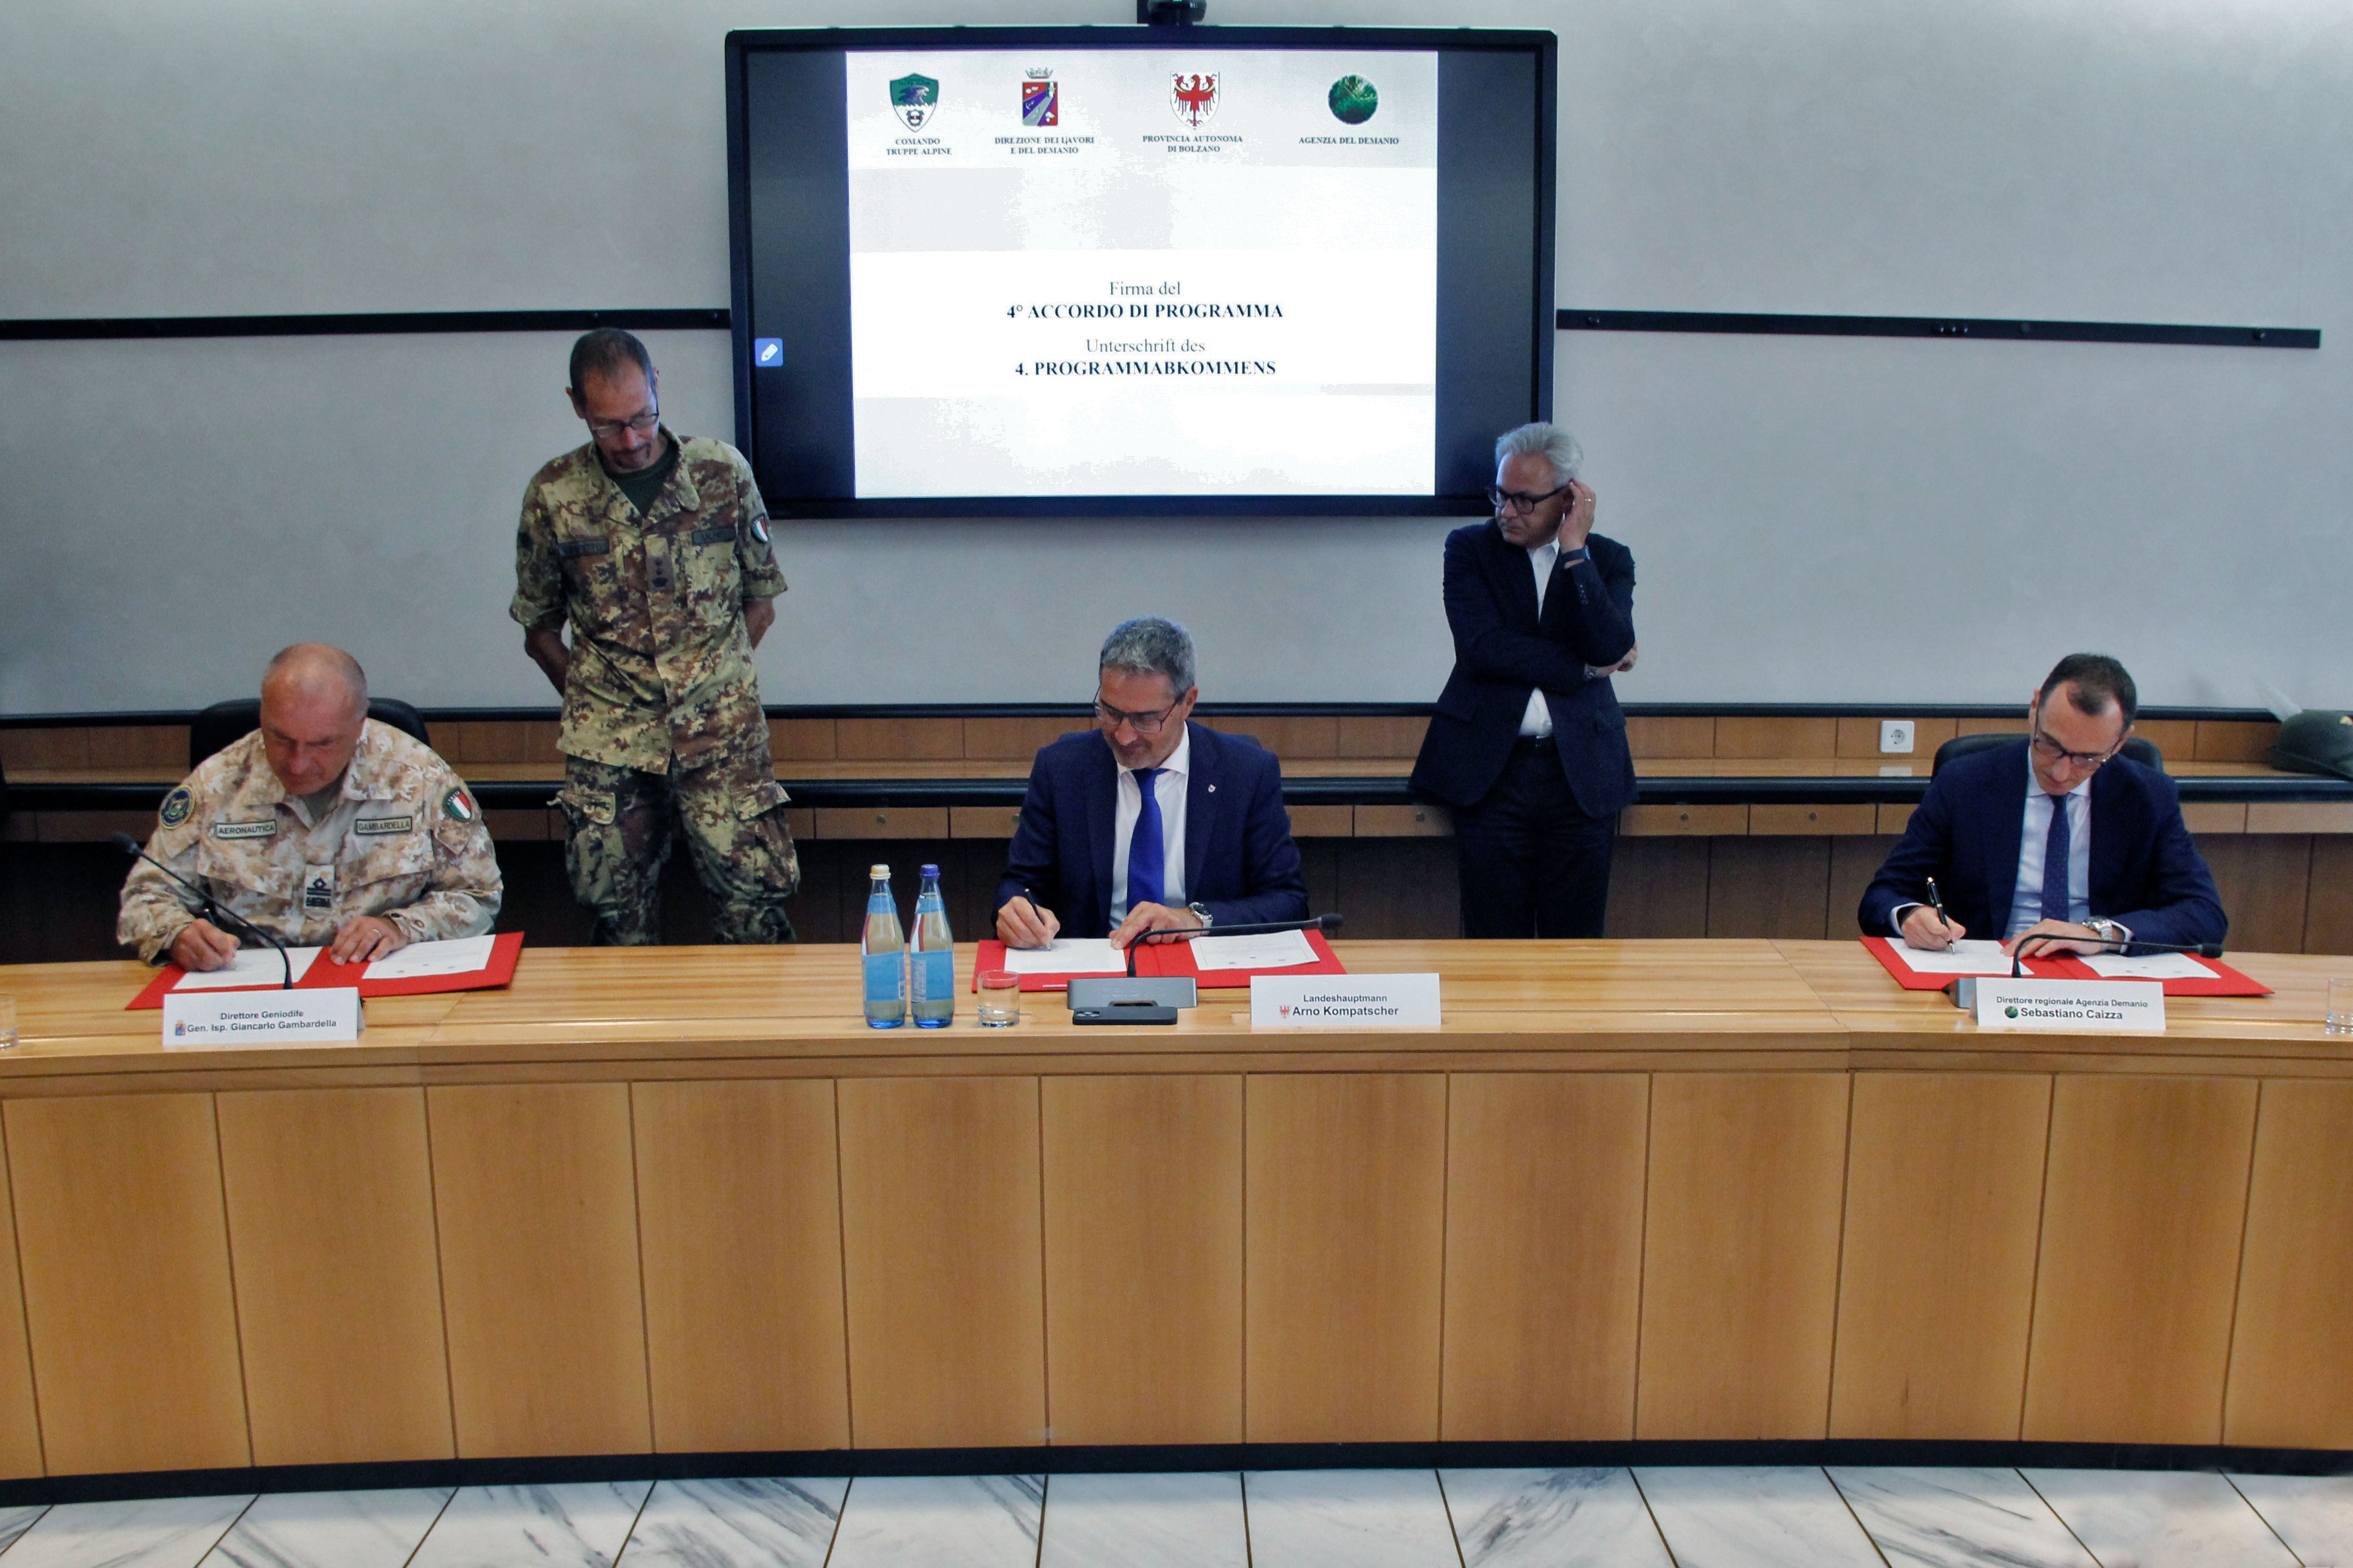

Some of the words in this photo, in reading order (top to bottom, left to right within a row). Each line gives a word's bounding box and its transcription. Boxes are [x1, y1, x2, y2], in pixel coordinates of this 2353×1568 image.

[1110, 282, 1154, 296] Firma
[1159, 281, 1181, 295] del
[1007, 304, 1023, 318] 4°
[1028, 304, 1124, 318] ACCORDO
[1130, 304, 1148, 318] DI
[1155, 304, 1283, 318] PROGRAMMA
[1086, 339, 1176, 353] Unterschrift
[1181, 339, 1205, 352] des
[1016, 362, 1028, 376] 4.
[1035, 361, 1276, 376] PROGRAMMABKOMMENS
[219, 825, 275, 834] AERONAUTICA
[359, 821, 410, 831] GAMBARDELLA
[1303, 995, 1388, 1003] Landeshauptmann
[1996, 996, 2033, 1005] Direttore
[2035, 998, 2073, 1007] regionale
[2075, 998, 2109, 1007] Agenzia
[2111, 999, 2148, 1007] Demanio
[221, 1012, 258, 1020] Direttore
[262, 1010, 303, 1018] Geniodife
[1293, 1006, 1320, 1016] Arno
[1324, 1006, 1399, 1017] Kompatscher
[2021, 1008, 2083, 1018] Sebastiano
[2086, 1010, 2123, 1019] Caizza
[212, 1023, 228, 1032] Isp.
[231, 1021, 275, 1031] Giancarlo
[279, 1019, 337, 1029] Gambardella
